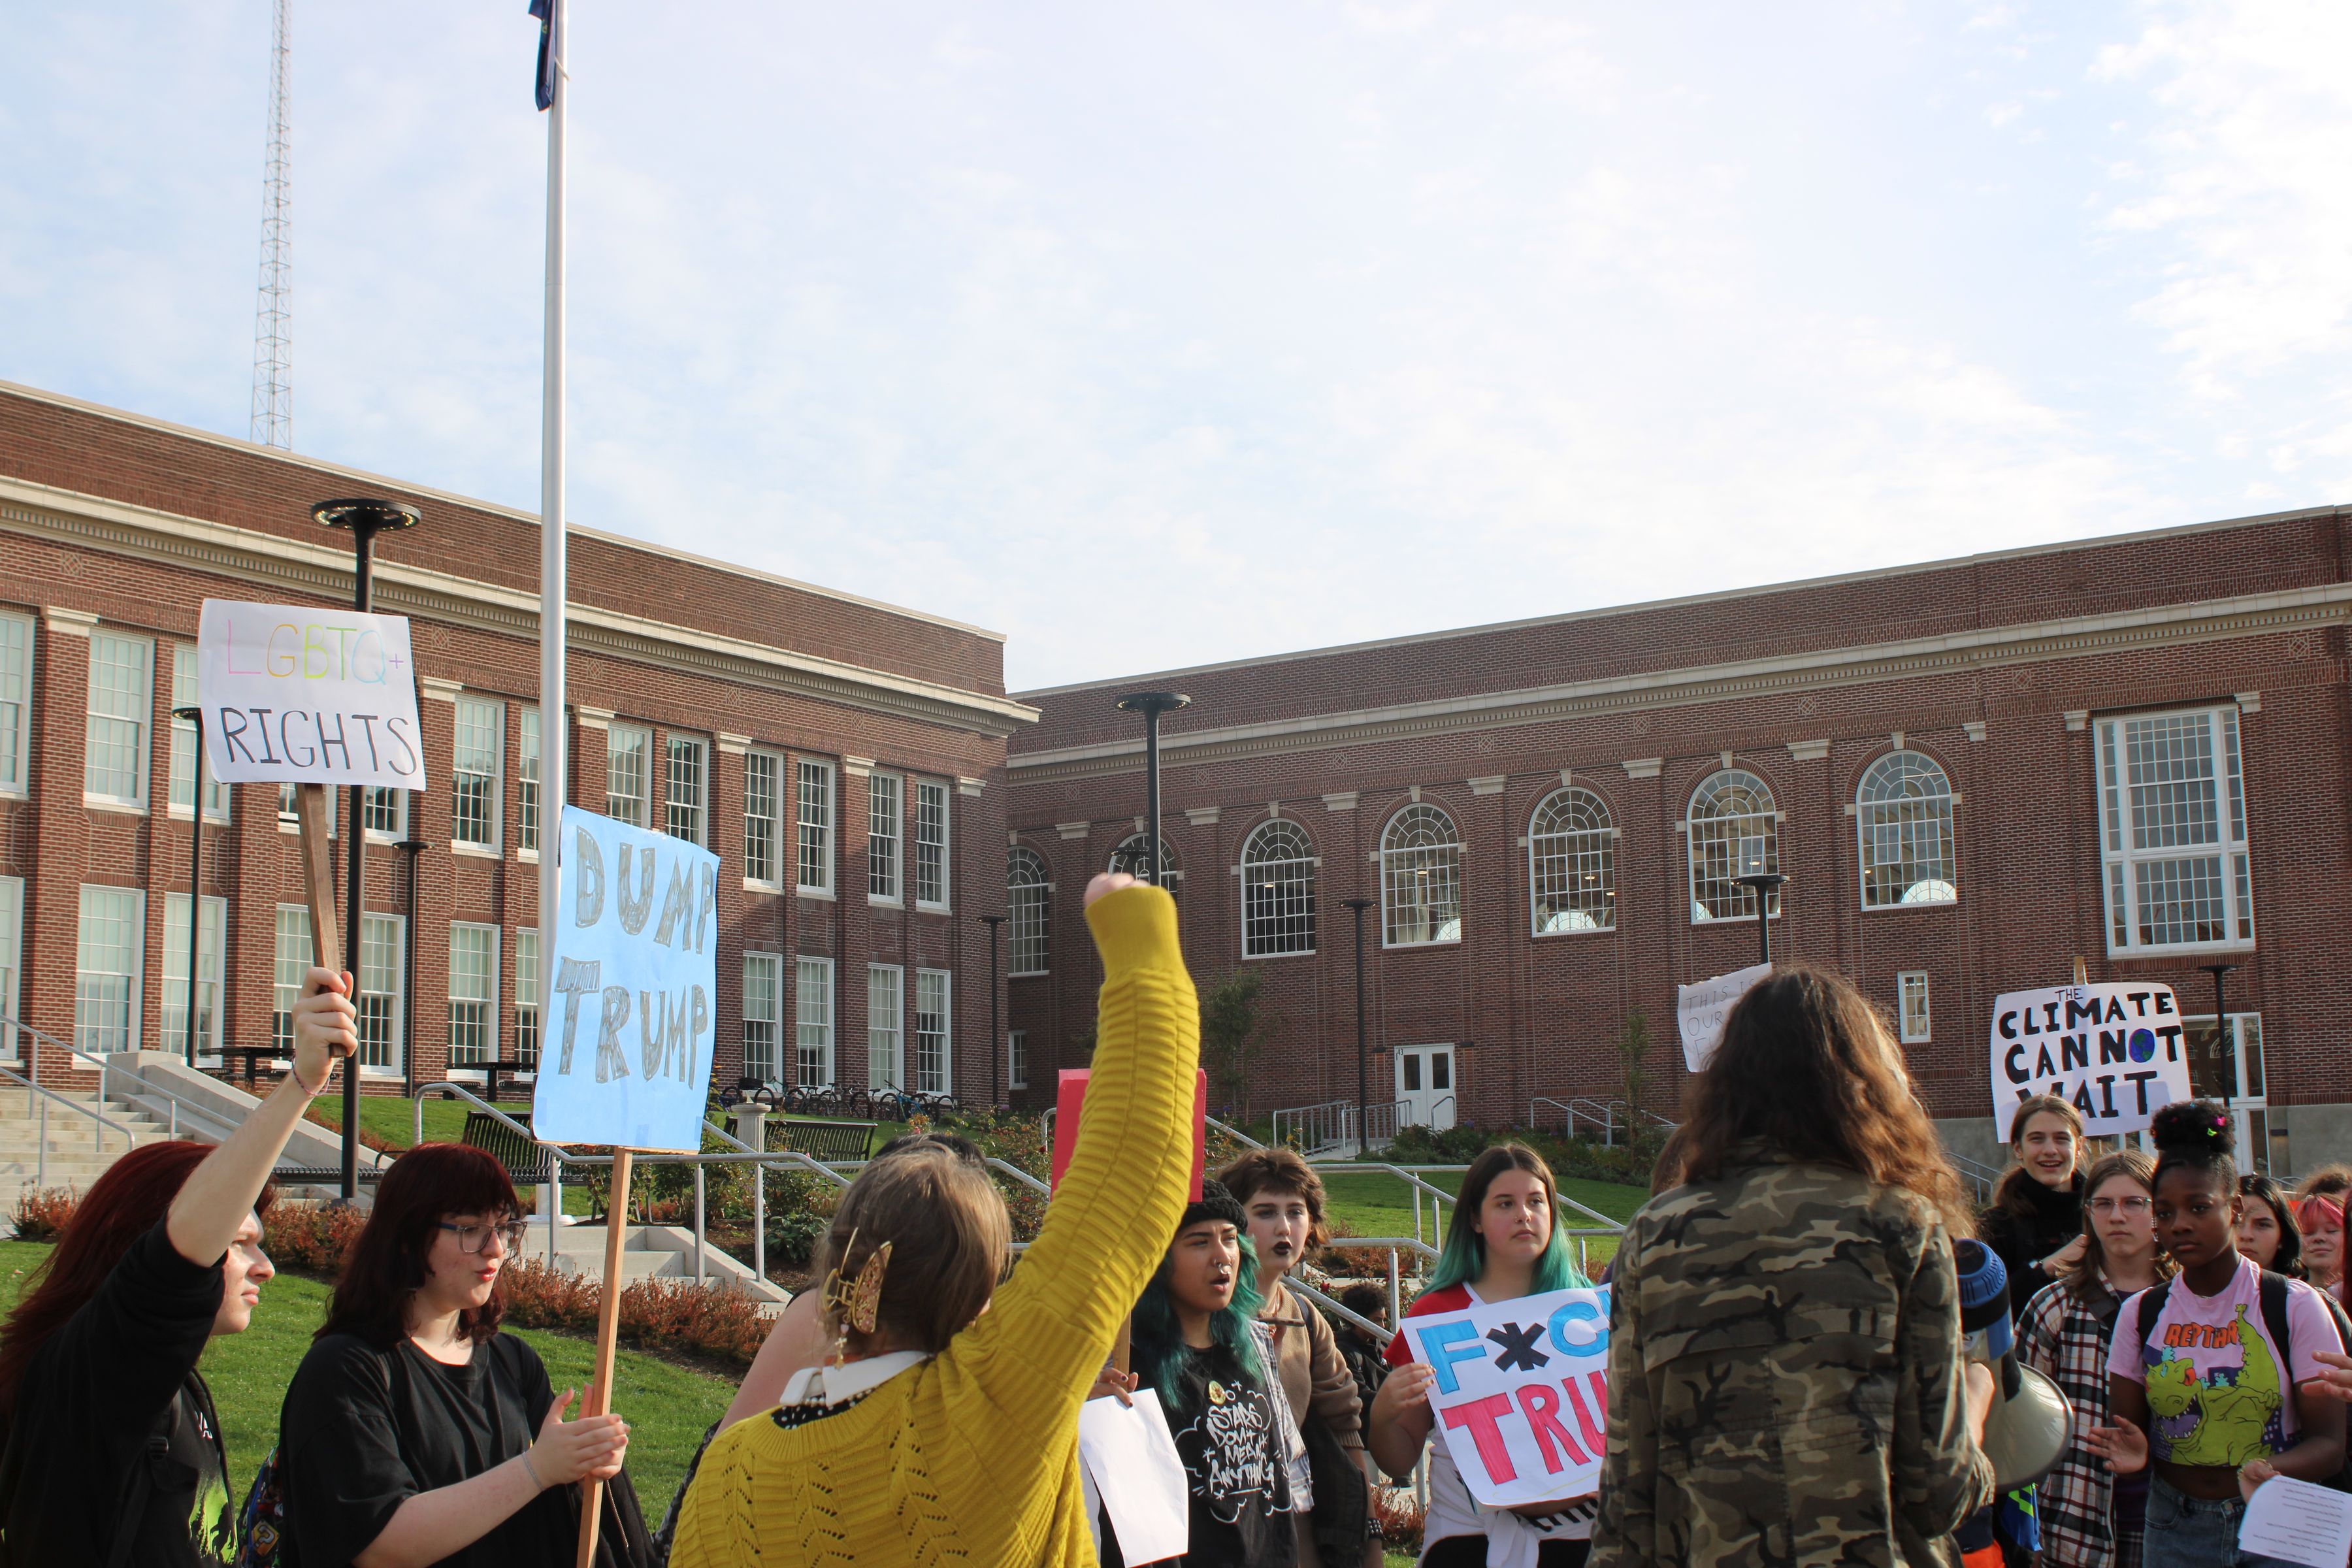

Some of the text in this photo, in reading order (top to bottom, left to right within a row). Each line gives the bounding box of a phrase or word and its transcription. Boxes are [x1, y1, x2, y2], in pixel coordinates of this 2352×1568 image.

[227, 619, 404, 685] LGBTQ+
[220, 707, 417, 776] RIGHTS
[576, 825, 715, 955] DUMP
[1686, 986, 1729, 1014] THIS
[1999, 992, 2173, 1040] CLIMATE
[2055, 988, 2084, 1002] THE
[555, 956, 710, 1090] TRUMP
[1687, 1011, 1723, 1036] OUR
[2004, 1024, 2182, 1085] CANNOT
[1416, 1290, 1612, 1396] FC
[2163, 1320, 2238, 1349] REPTAR
[1208, 1402, 1263, 1429] STARS
[1439, 1368, 1609, 1486] TRU
[1209, 1452, 1275, 1494] ANYTHING
[1224, 1435, 1262, 1466] MEAN
